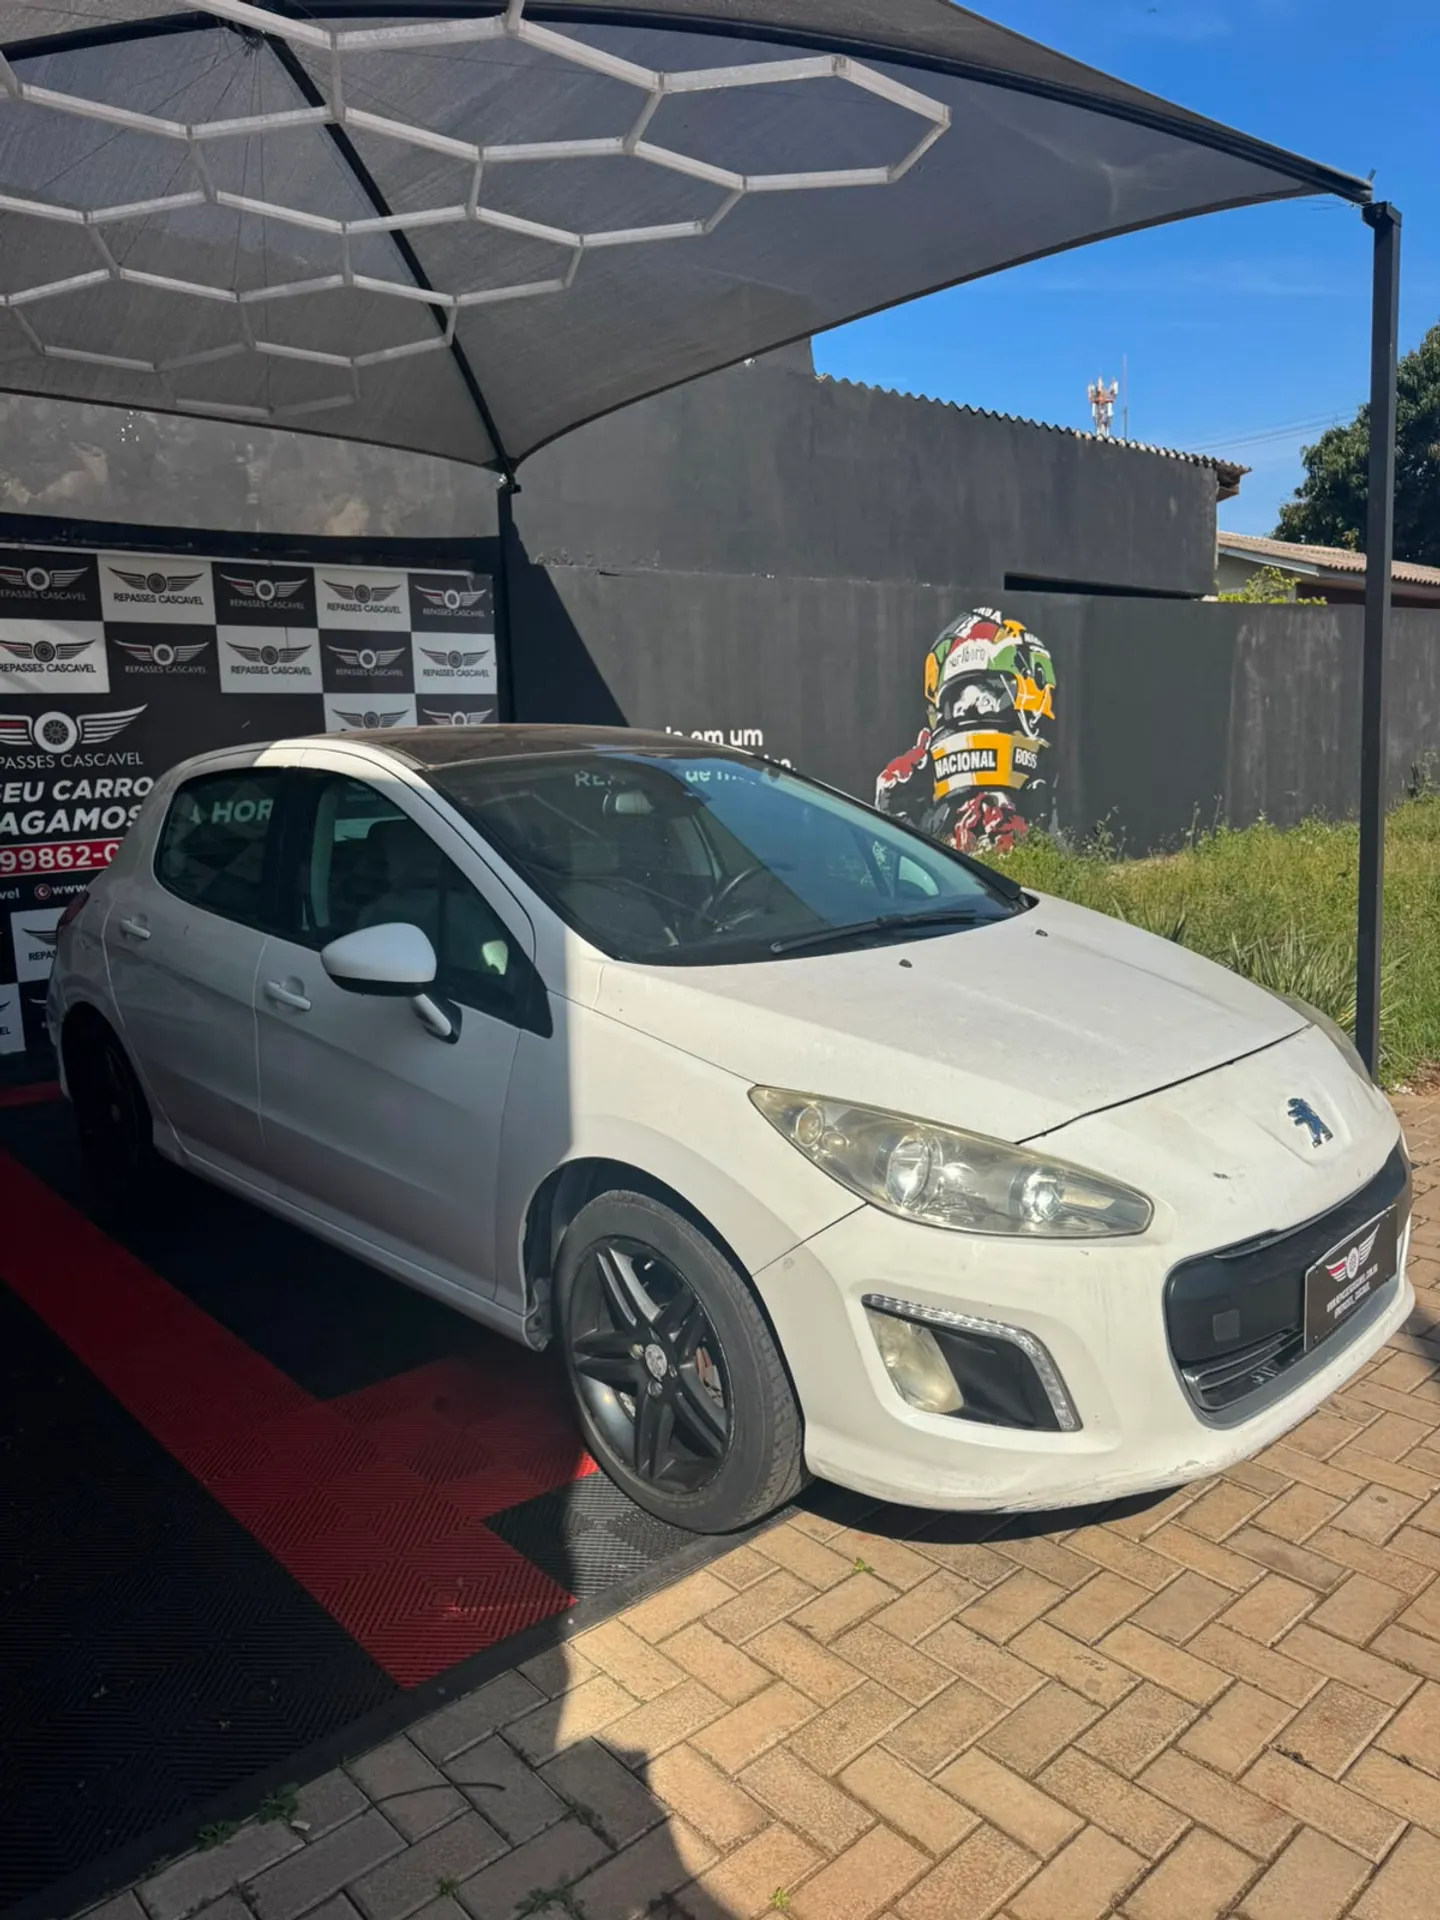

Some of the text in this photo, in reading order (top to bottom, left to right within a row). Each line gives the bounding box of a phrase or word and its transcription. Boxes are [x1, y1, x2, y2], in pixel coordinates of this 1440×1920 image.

[41, 591, 87, 601] CASCAVEL
[113, 593, 204, 605] REPASSES CASCAVEL
[327, 602, 402, 614] REPASSES CASCAVEL
[422, 608, 485, 617] REPASSES CASCAVEL
[46, 663, 96, 673] CASCAVEL
[125, 665, 207, 674] REPASSES CASCAVEL
[231, 665, 312, 675] REPASSES CASCAVEL
[335, 668, 403, 677] REPASSES CASCAVEL
[422, 668, 490, 678] REPASSES CASCAVEL
[730, 729, 763, 746] um
[60, 752, 144, 768] CASCAVEL
[935, 747, 1038, 779] NACIONAL BOSS
[0, 776, 155, 803] EU CARRO
